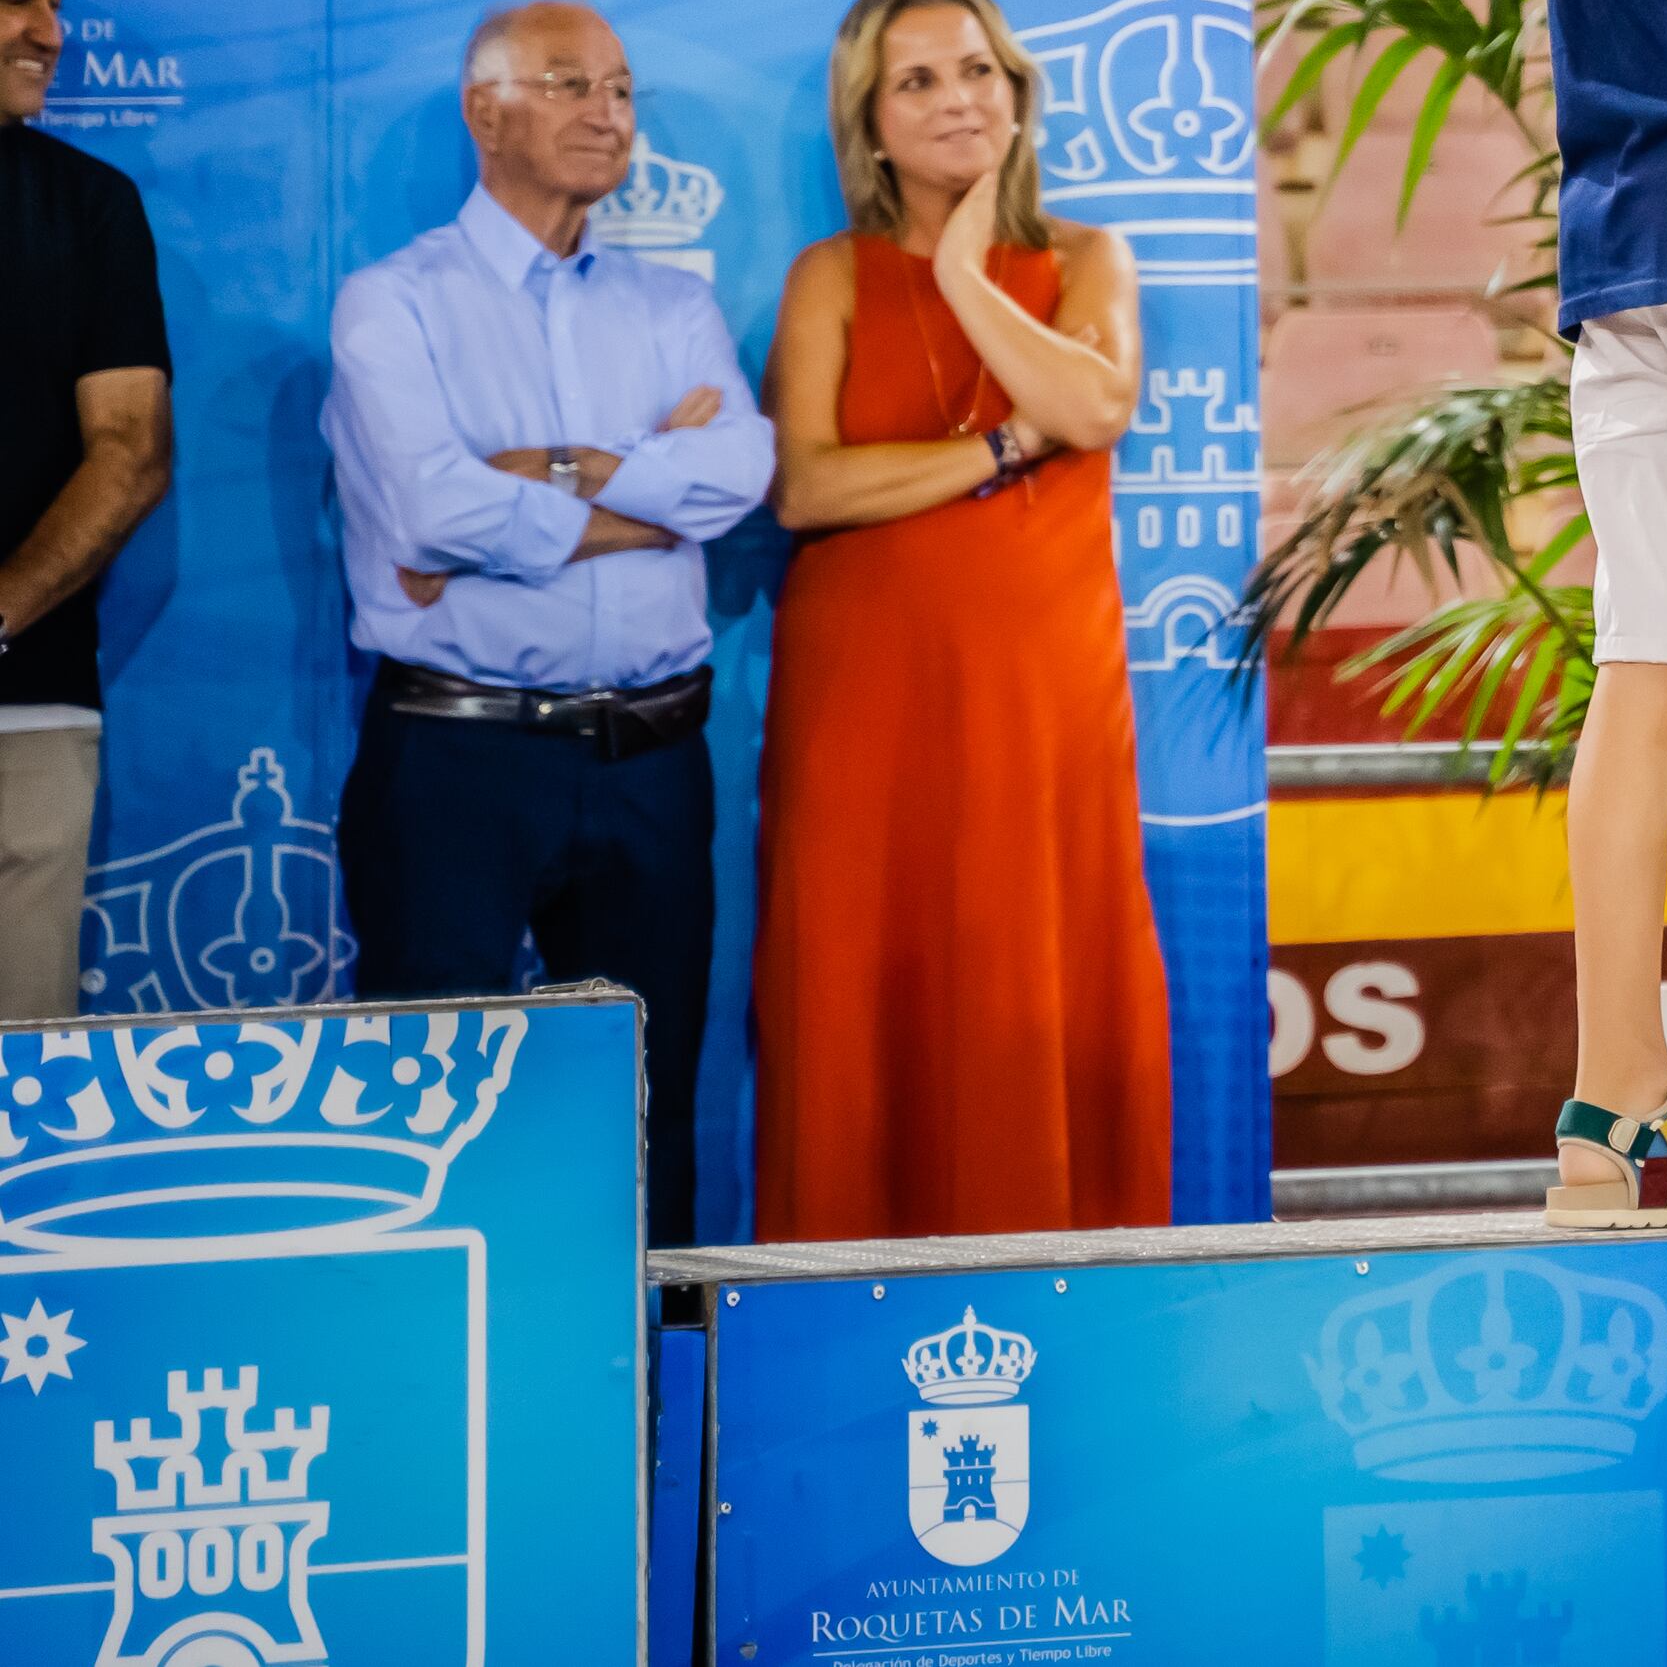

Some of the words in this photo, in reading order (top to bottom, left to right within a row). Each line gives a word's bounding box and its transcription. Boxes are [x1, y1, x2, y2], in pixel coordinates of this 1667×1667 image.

[82, 18, 115, 42] DE
[866, 1571, 1046, 1599] AYUNTAMIENTO
[1053, 1569, 1079, 1587] DE
[1000, 1604, 1037, 1631] DE
[938, 1653, 1002, 1667] Deportes
[1007, 1652, 1015, 1665] y
[1019, 1648, 1071, 1663] Tiempo
[1075, 1645, 1112, 1659] Libre
